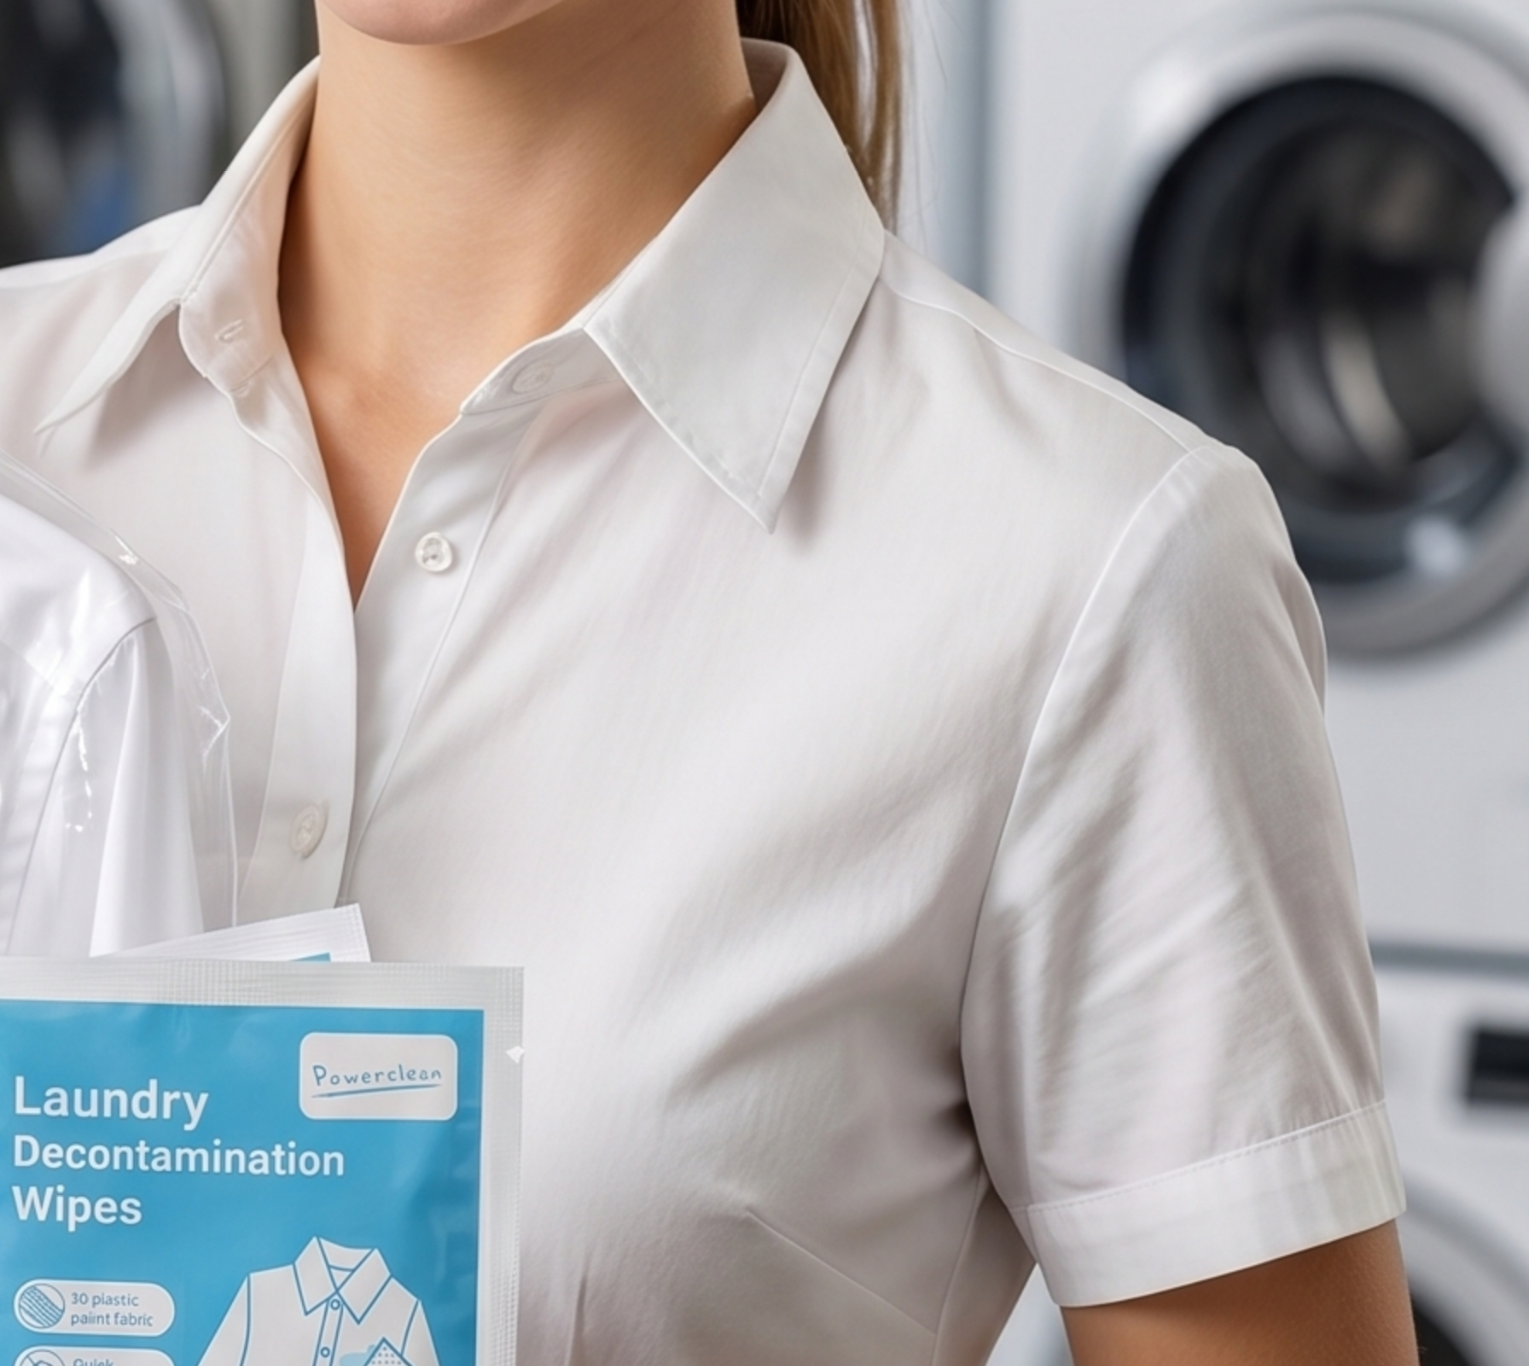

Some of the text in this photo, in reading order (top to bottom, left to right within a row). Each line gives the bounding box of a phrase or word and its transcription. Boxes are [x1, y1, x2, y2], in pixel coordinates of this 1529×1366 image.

[313, 1064, 442, 1087] Powerclean
[14, 1076, 209, 1131] Laundry
[13, 1134, 345, 1177] Decontamination
[11, 1184, 143, 1233] Wipes
[71, 1292, 89, 1306] 30
[114, 1312, 154, 1328] fabric
